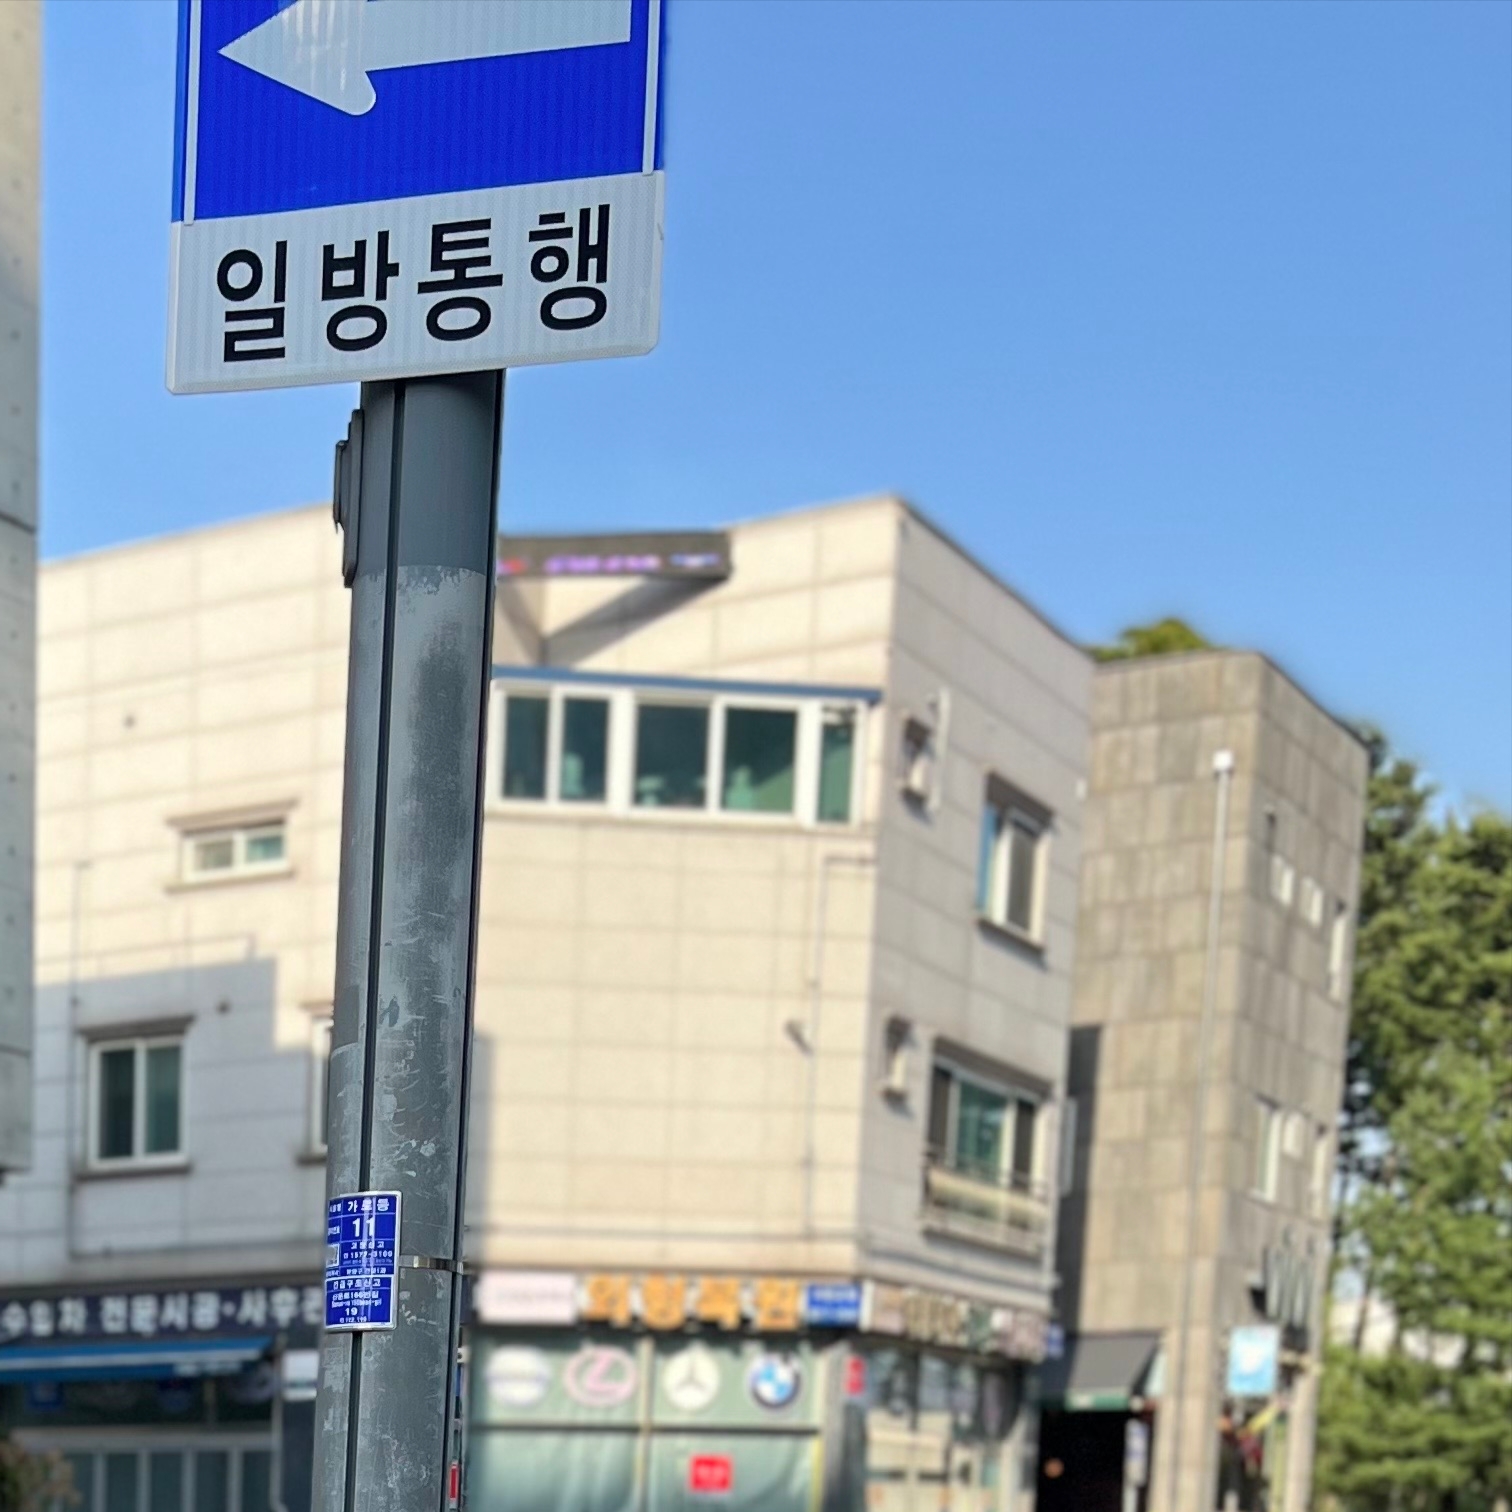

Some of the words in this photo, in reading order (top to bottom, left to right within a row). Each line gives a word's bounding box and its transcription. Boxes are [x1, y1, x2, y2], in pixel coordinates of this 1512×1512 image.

[216, 203, 610, 362] 일방통행
[352, 1217, 375, 1238] 11
[345, 1307, 358, 1316] 19
